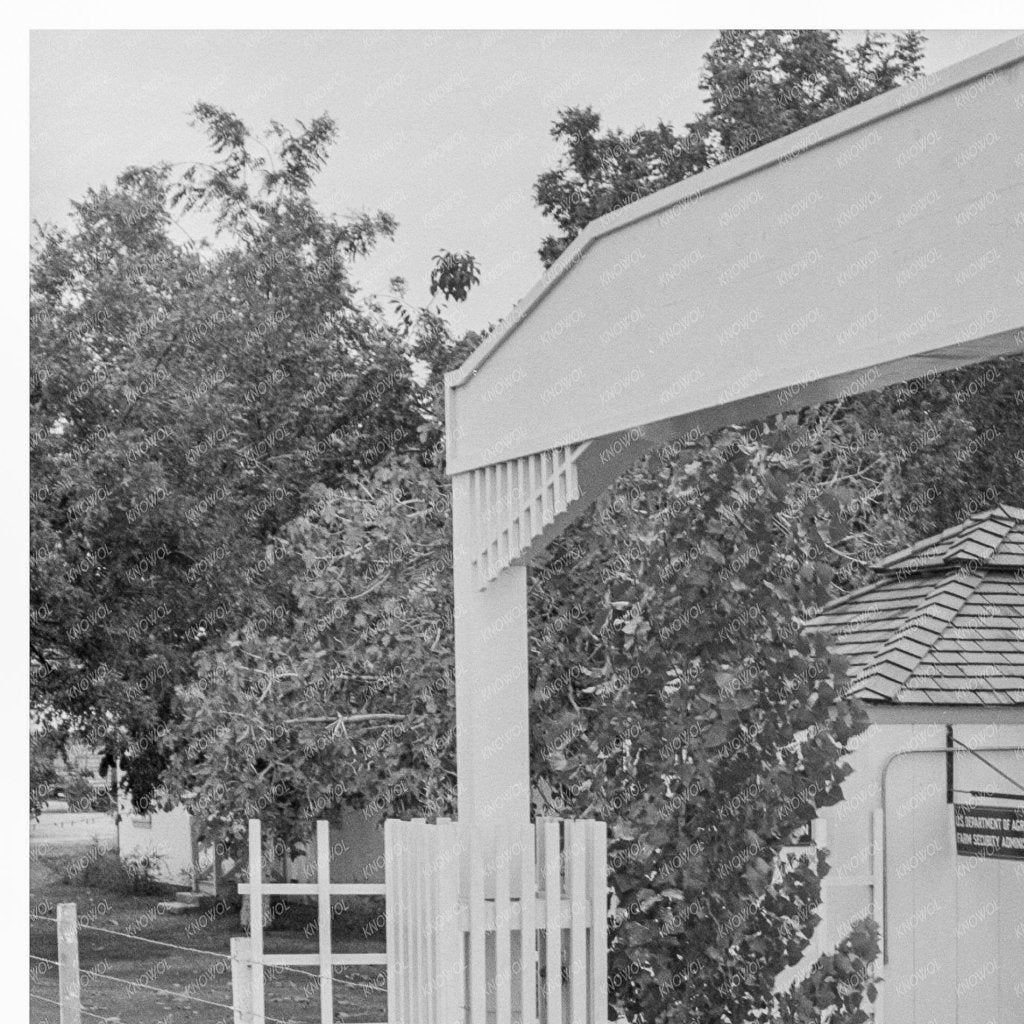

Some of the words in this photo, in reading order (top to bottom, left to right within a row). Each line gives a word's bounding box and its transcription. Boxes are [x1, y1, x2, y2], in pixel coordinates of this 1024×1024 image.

[964, 815, 1002, 830] DEPARTMENT
[1003, 818, 1010, 830] OF
[957, 832, 971, 844] FARM
[972, 833, 1000, 848] SECURITY
